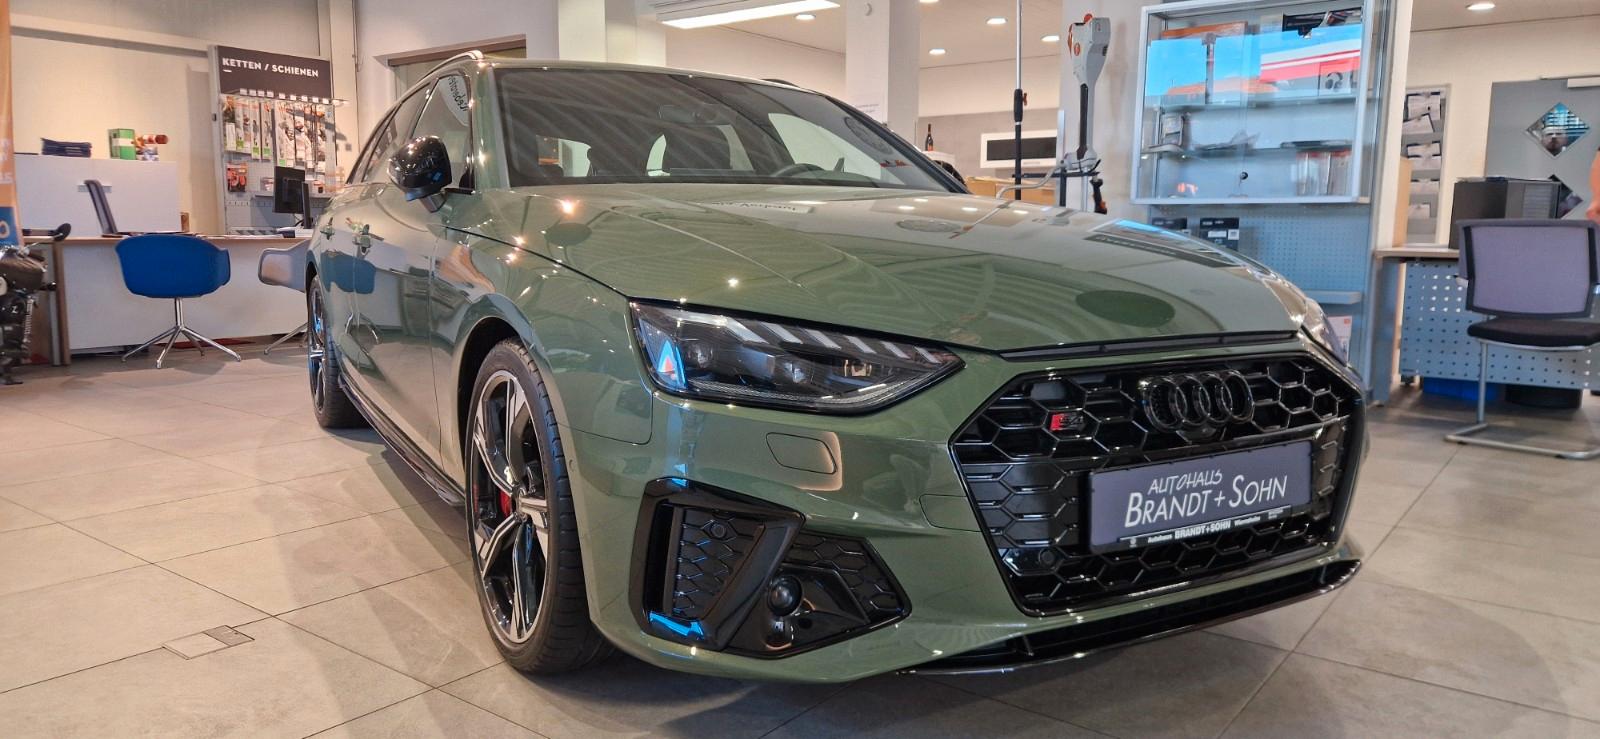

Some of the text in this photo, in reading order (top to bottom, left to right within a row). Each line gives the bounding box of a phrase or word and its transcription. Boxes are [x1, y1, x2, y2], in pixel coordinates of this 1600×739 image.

[222, 57, 319, 77] KETTEN / SCHIENEN
[1147, 469, 1223, 496] AUTOHAUS
[1124, 489, 1212, 528] BRANDT
[1229, 474, 1288, 508] SOHN
